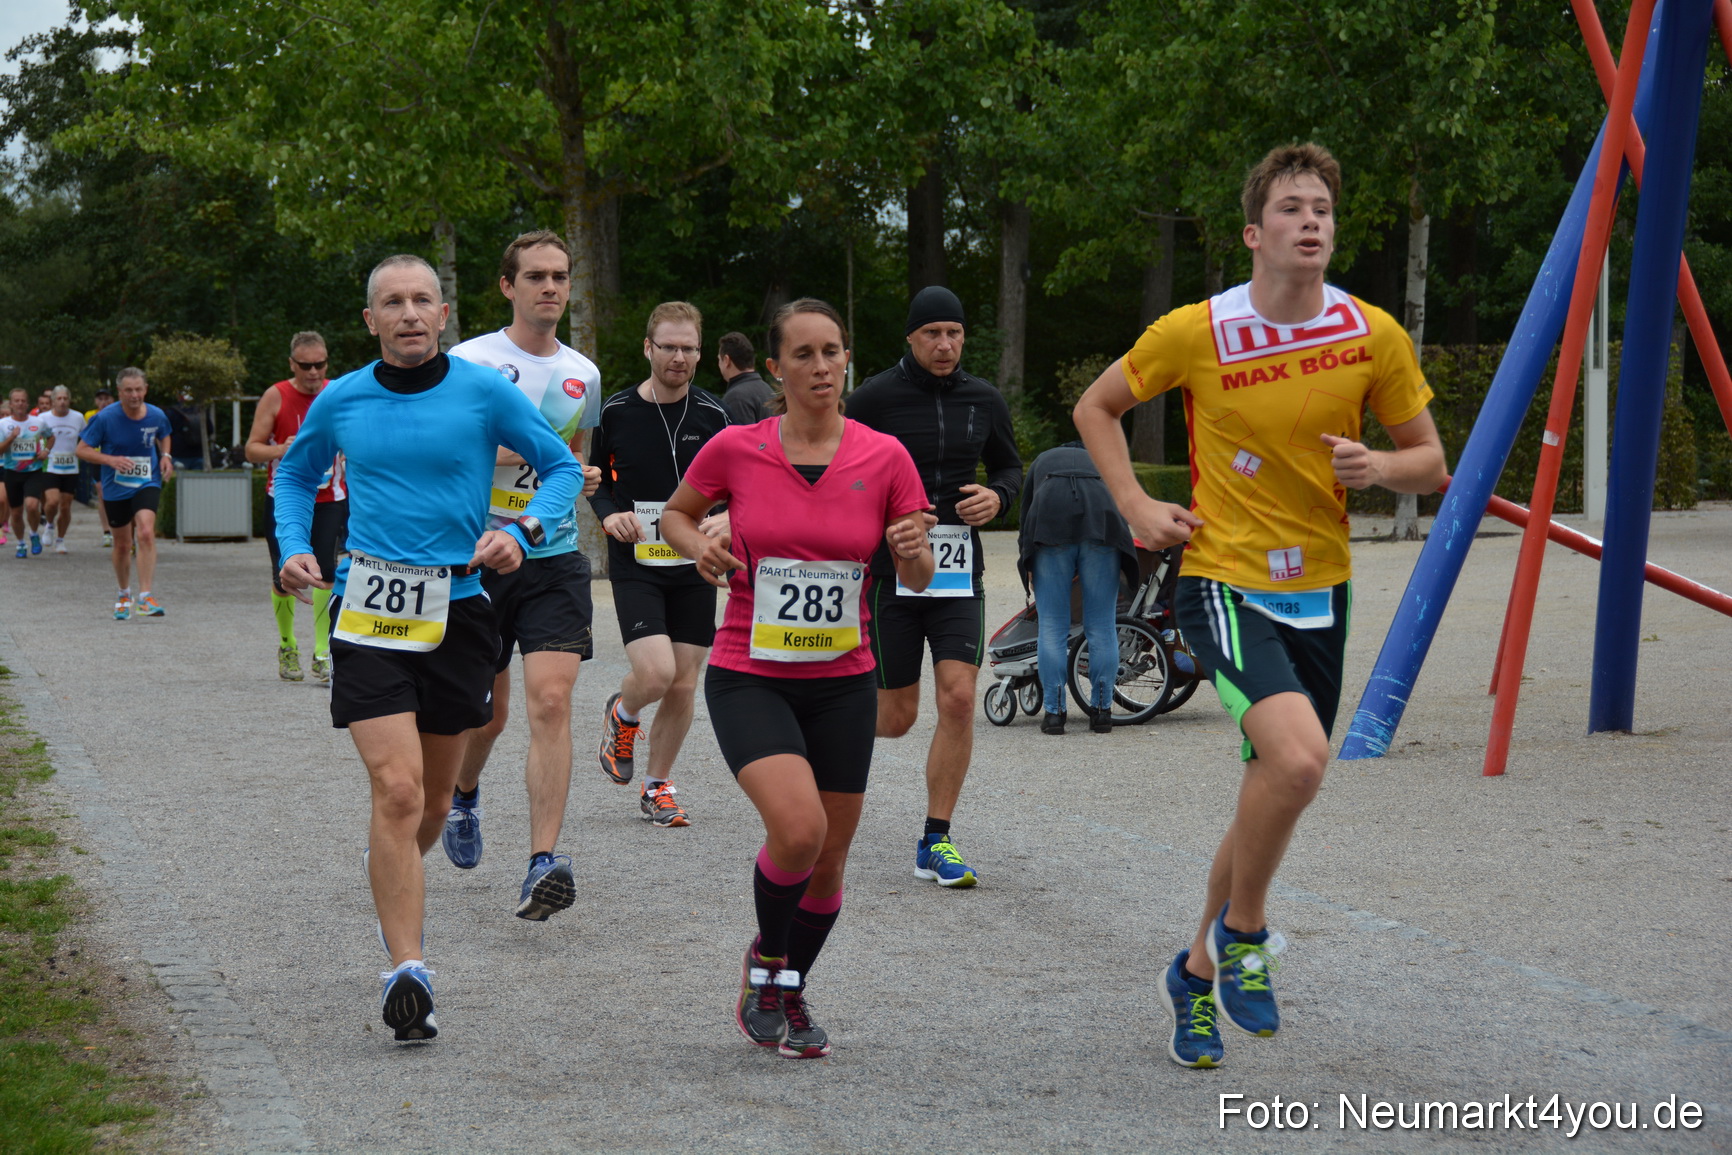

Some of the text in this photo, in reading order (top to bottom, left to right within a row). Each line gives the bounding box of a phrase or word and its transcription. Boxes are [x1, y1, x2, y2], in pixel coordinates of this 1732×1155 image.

[1220, 346, 1373, 391] MAX BÖGL
[508, 495, 532, 508] Flor
[648, 547, 680, 557] Sebas
[353, 557, 434, 577] PARTL Neumarkt
[759, 565, 849, 580] PARTL Neumarkt
[364, 575, 426, 615] 281
[777, 583, 844, 623] 283
[372, 620, 409, 637] Horst
[783, 631, 833, 648] Kerstin
